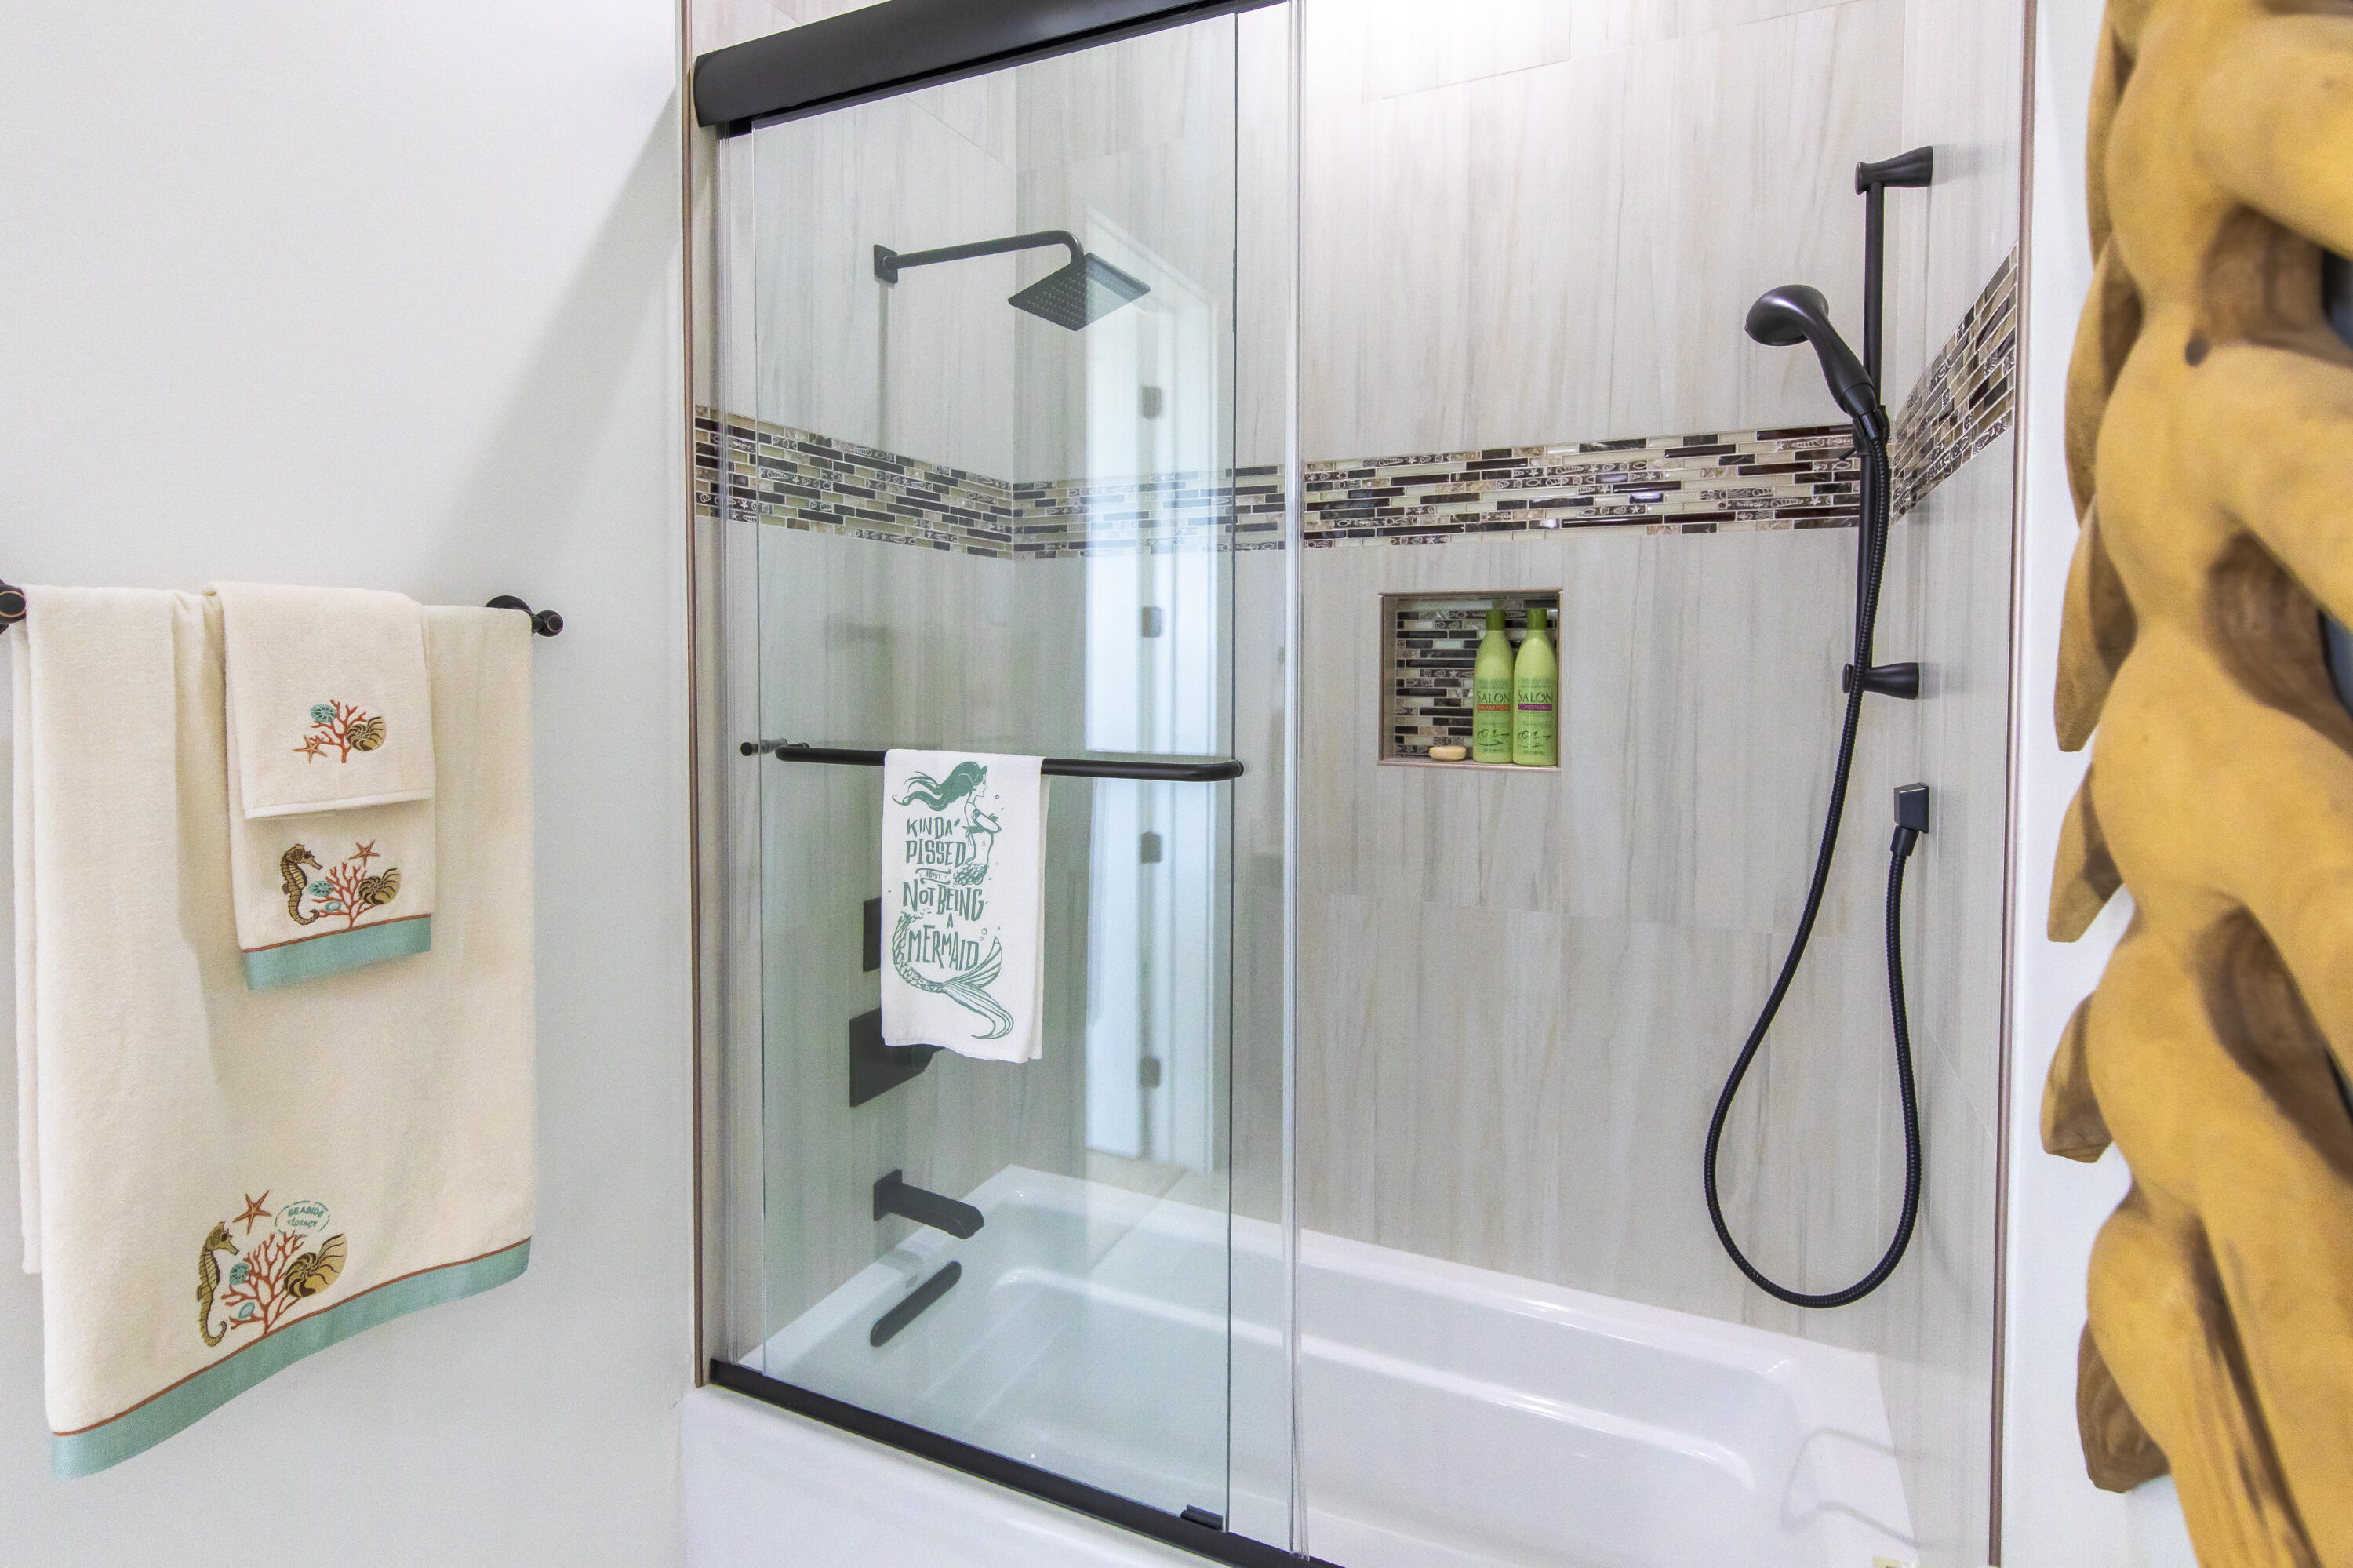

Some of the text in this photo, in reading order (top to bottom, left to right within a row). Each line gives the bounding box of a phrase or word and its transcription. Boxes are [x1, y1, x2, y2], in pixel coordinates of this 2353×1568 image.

[1477, 691, 1511, 704] SALON
[1518, 690, 1553, 704] SALON
[905, 839, 966, 868] PISSED
[925, 871, 941, 880] ABOUT
[937, 884, 984, 922] BEING
[947, 912, 954, 929] A
[907, 925, 980, 971] MERMAID
[288, 1206, 325, 1217] SEASIDE
